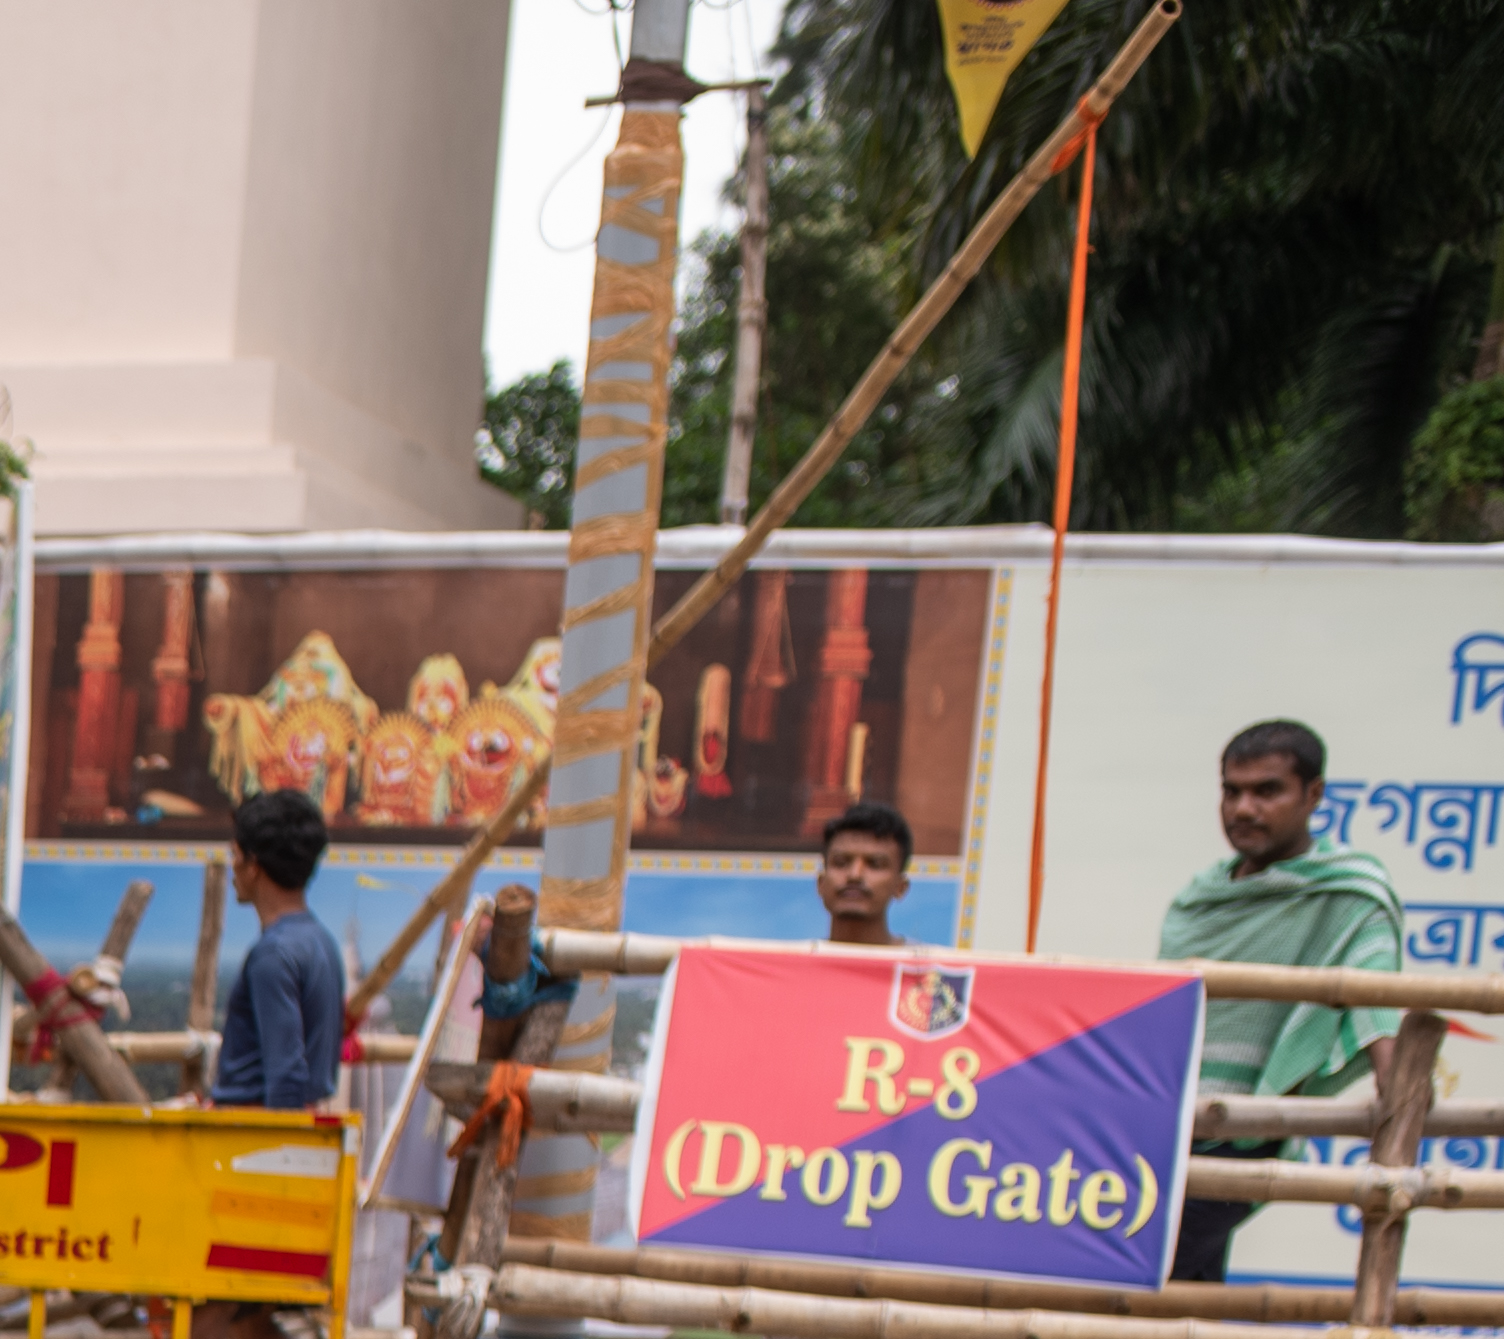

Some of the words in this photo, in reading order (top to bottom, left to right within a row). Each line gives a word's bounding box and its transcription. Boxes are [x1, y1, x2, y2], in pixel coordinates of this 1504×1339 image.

[1308, 780, 1504, 873] জগন্না
[836, 1035, 982, 1121] R-8
[663, 1119, 903, 1228] (Drop
[927, 1138, 1159, 1239] Gate)
